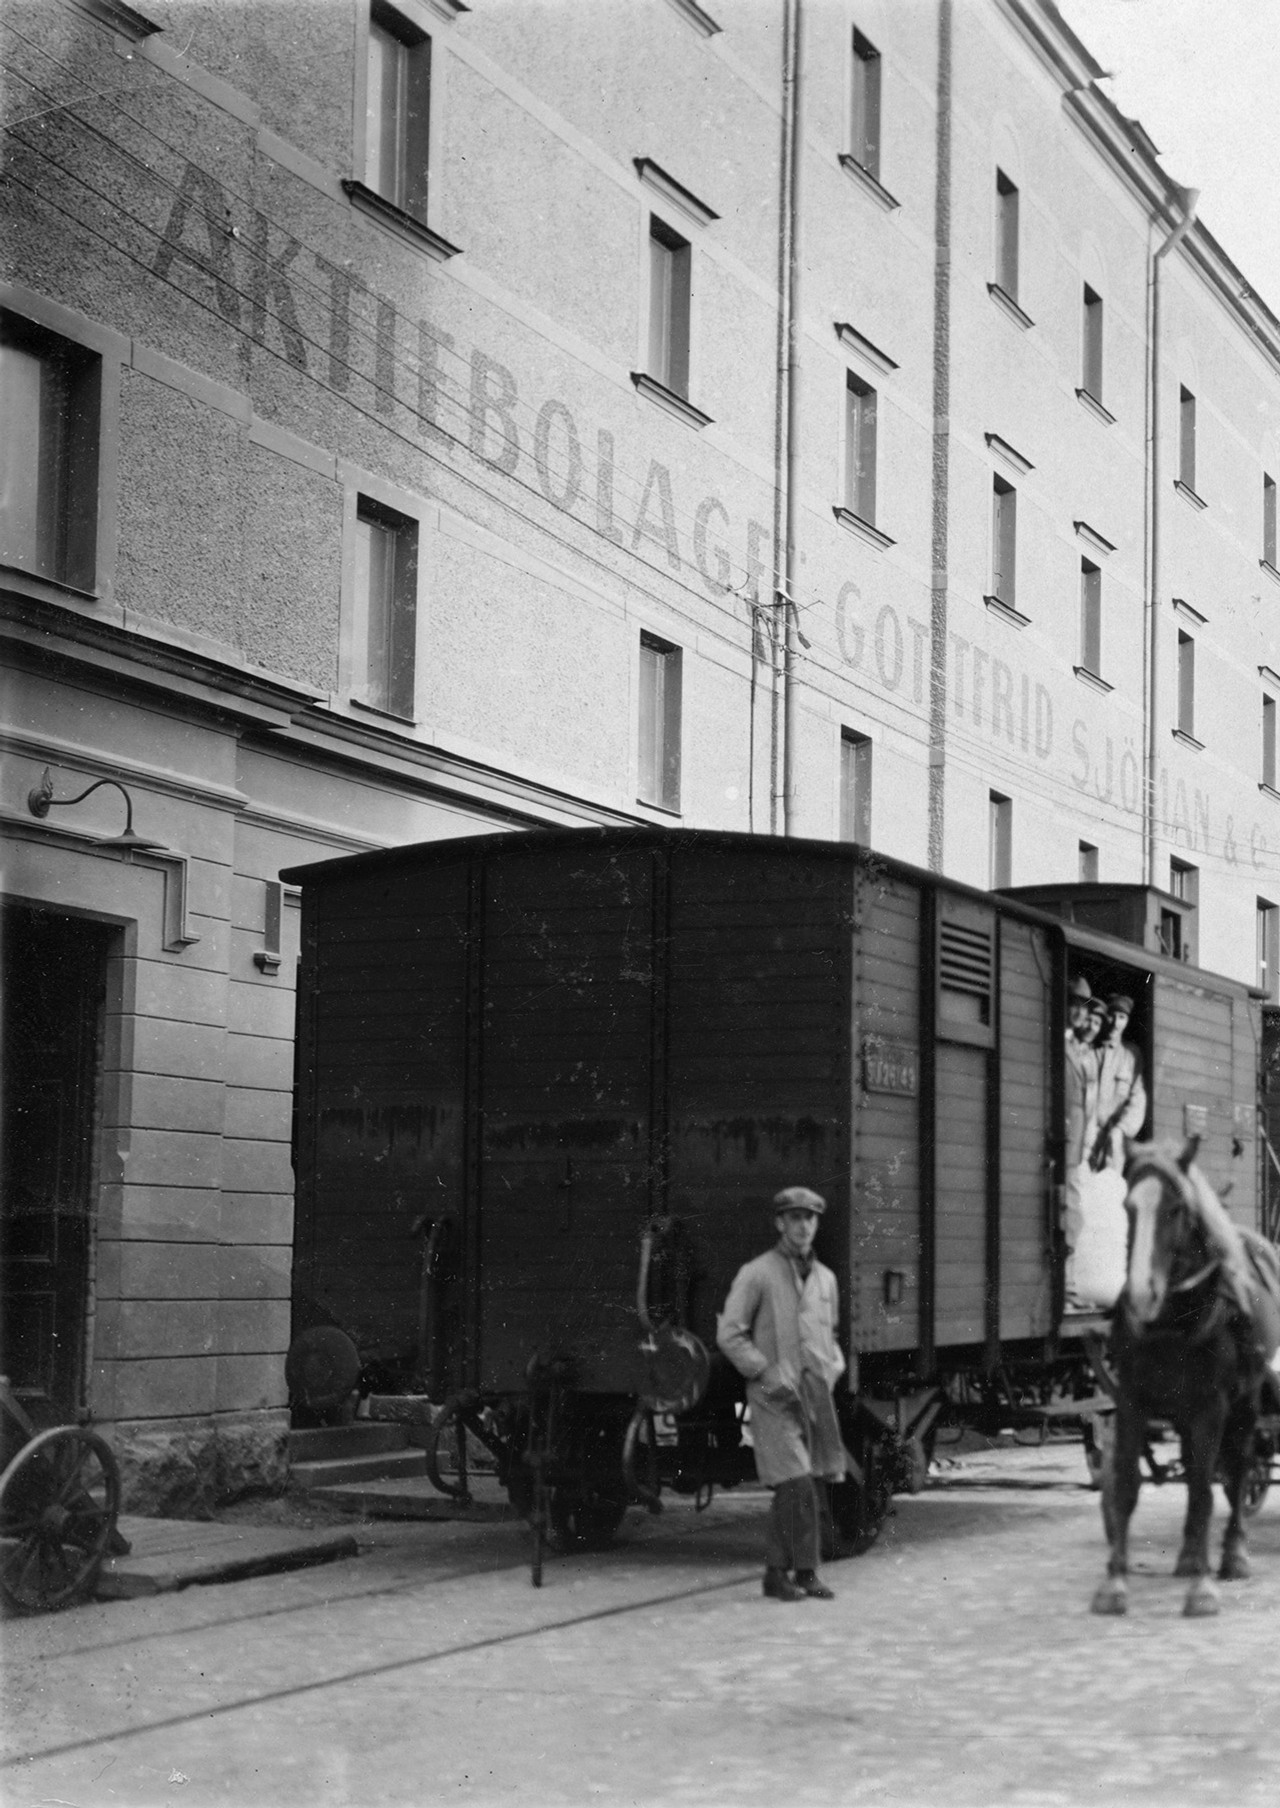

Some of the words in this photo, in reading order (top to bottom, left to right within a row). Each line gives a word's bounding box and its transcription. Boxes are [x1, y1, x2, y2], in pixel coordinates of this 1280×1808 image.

[152, 163, 806, 628] AKTIEBOLAGE
[834, 580, 1054, 760] GOTTFRID
[1223, 813, 1239, 868] &
